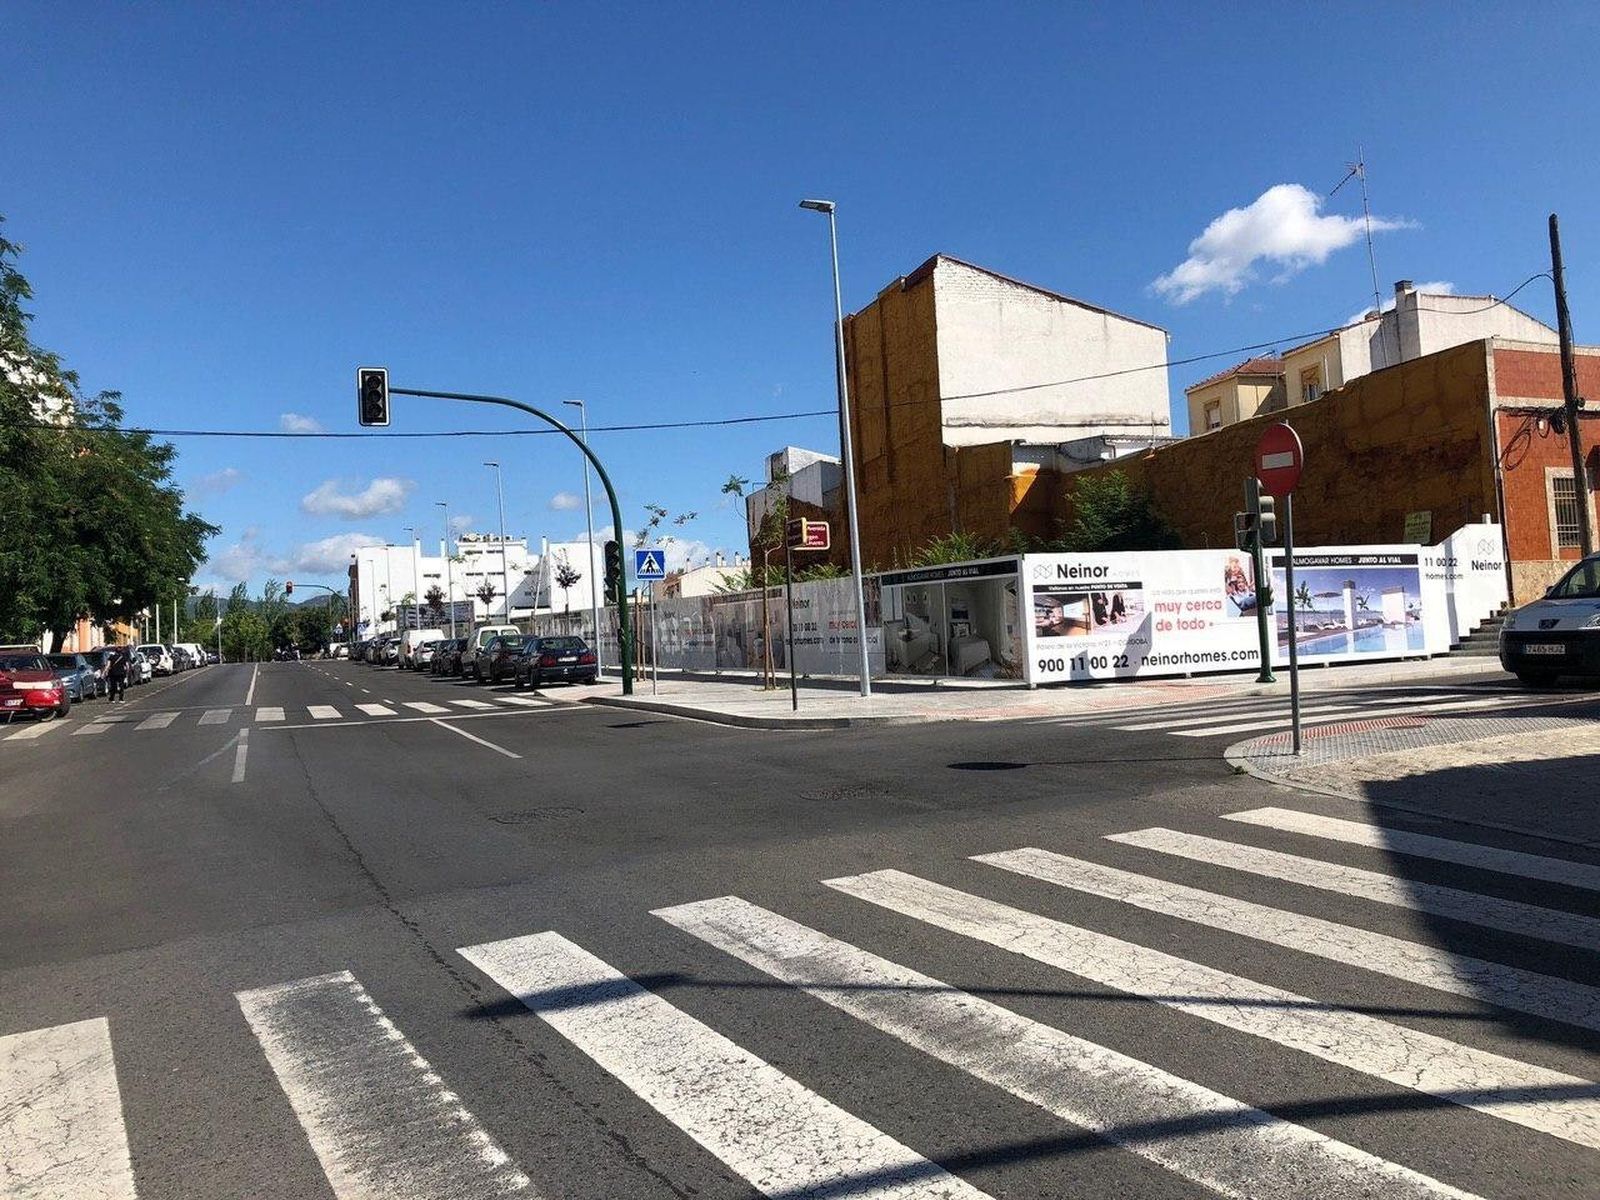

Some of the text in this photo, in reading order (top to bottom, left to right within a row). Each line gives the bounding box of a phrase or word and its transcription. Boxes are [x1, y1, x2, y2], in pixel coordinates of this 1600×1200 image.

[1424, 557, 1433, 567] 11
[1448, 556, 1458, 567] 22
[1471, 559, 1502, 571] Neinor
[1057, 563, 1109, 579] Neinor
[1154, 600, 1222, 615] muy cerca
[1155, 617, 1206, 632] de todo
[1038, 649, 1260, 673] 900 11 00 22 neinorhomes.com
